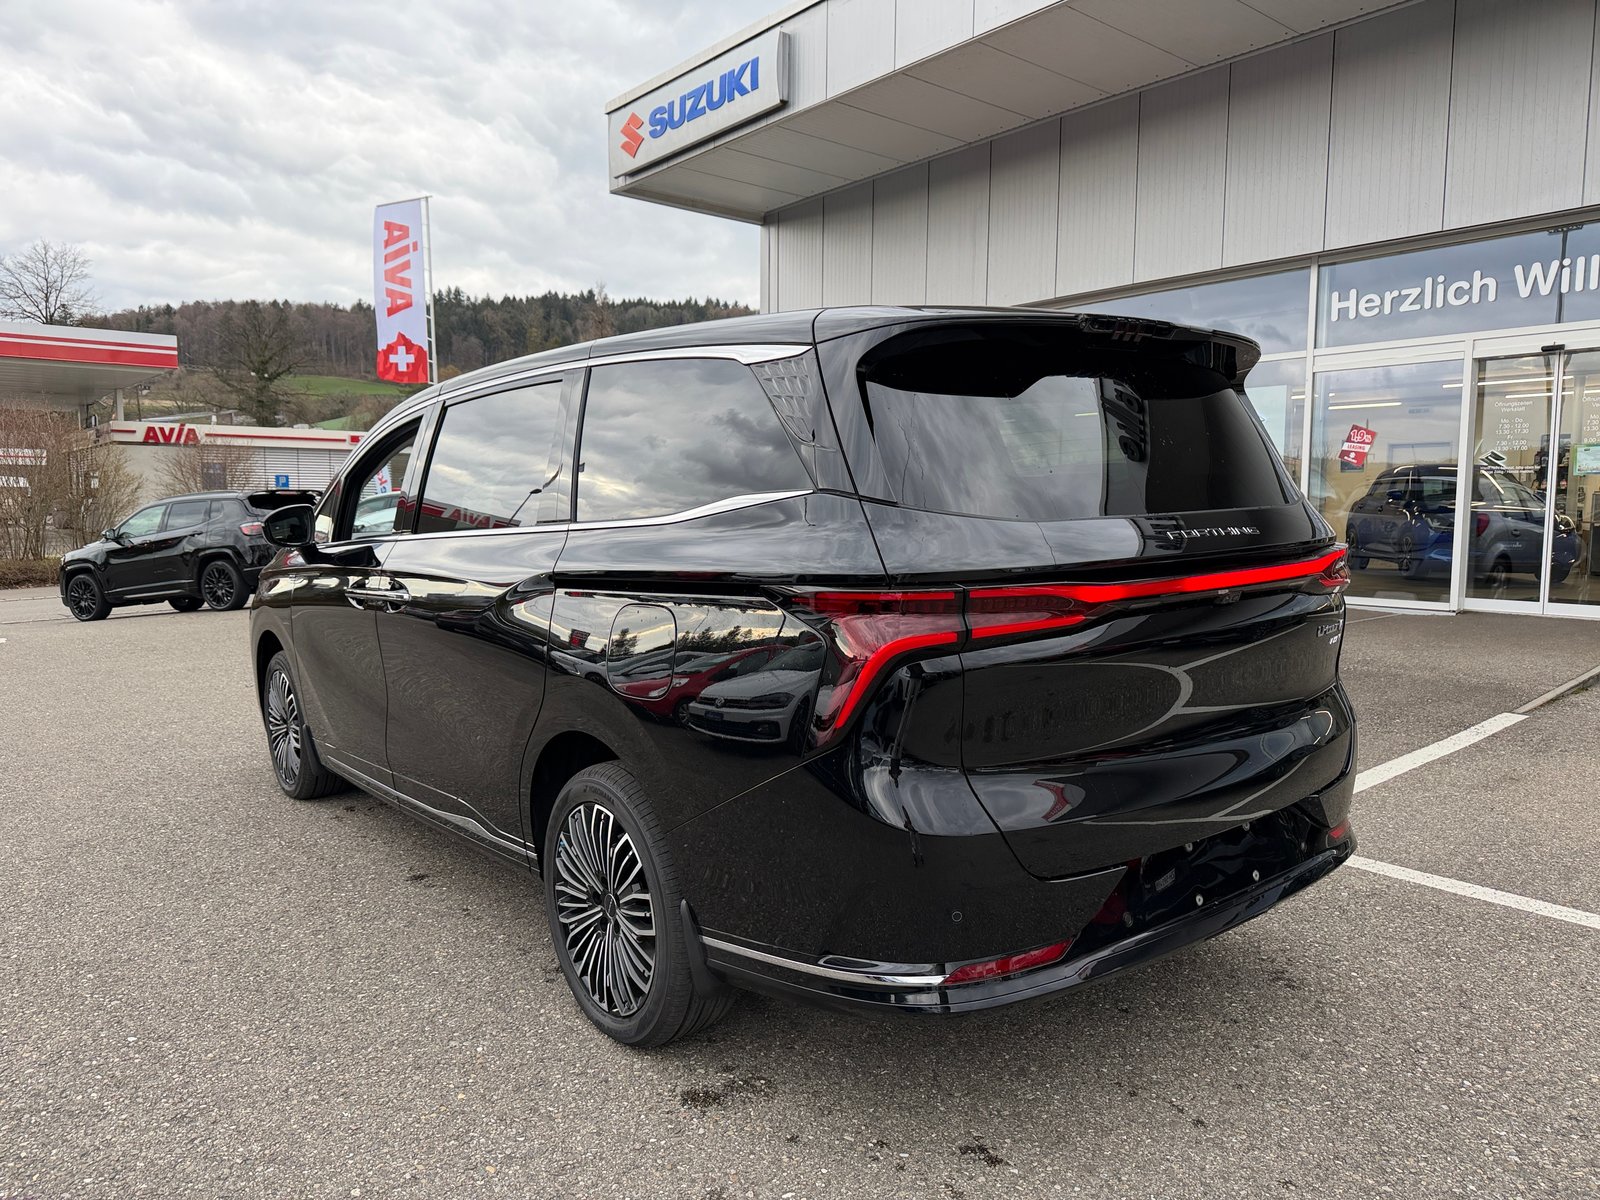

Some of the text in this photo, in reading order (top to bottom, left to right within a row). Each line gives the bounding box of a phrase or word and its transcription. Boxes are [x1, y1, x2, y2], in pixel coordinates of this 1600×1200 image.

[648, 56, 760, 139] SUZUKI
[1330, 254, 1600, 322] Herzlich Will
[1347, 443, 1366, 451] LEASING
[1166, 526, 1261, 540] FORTHING
